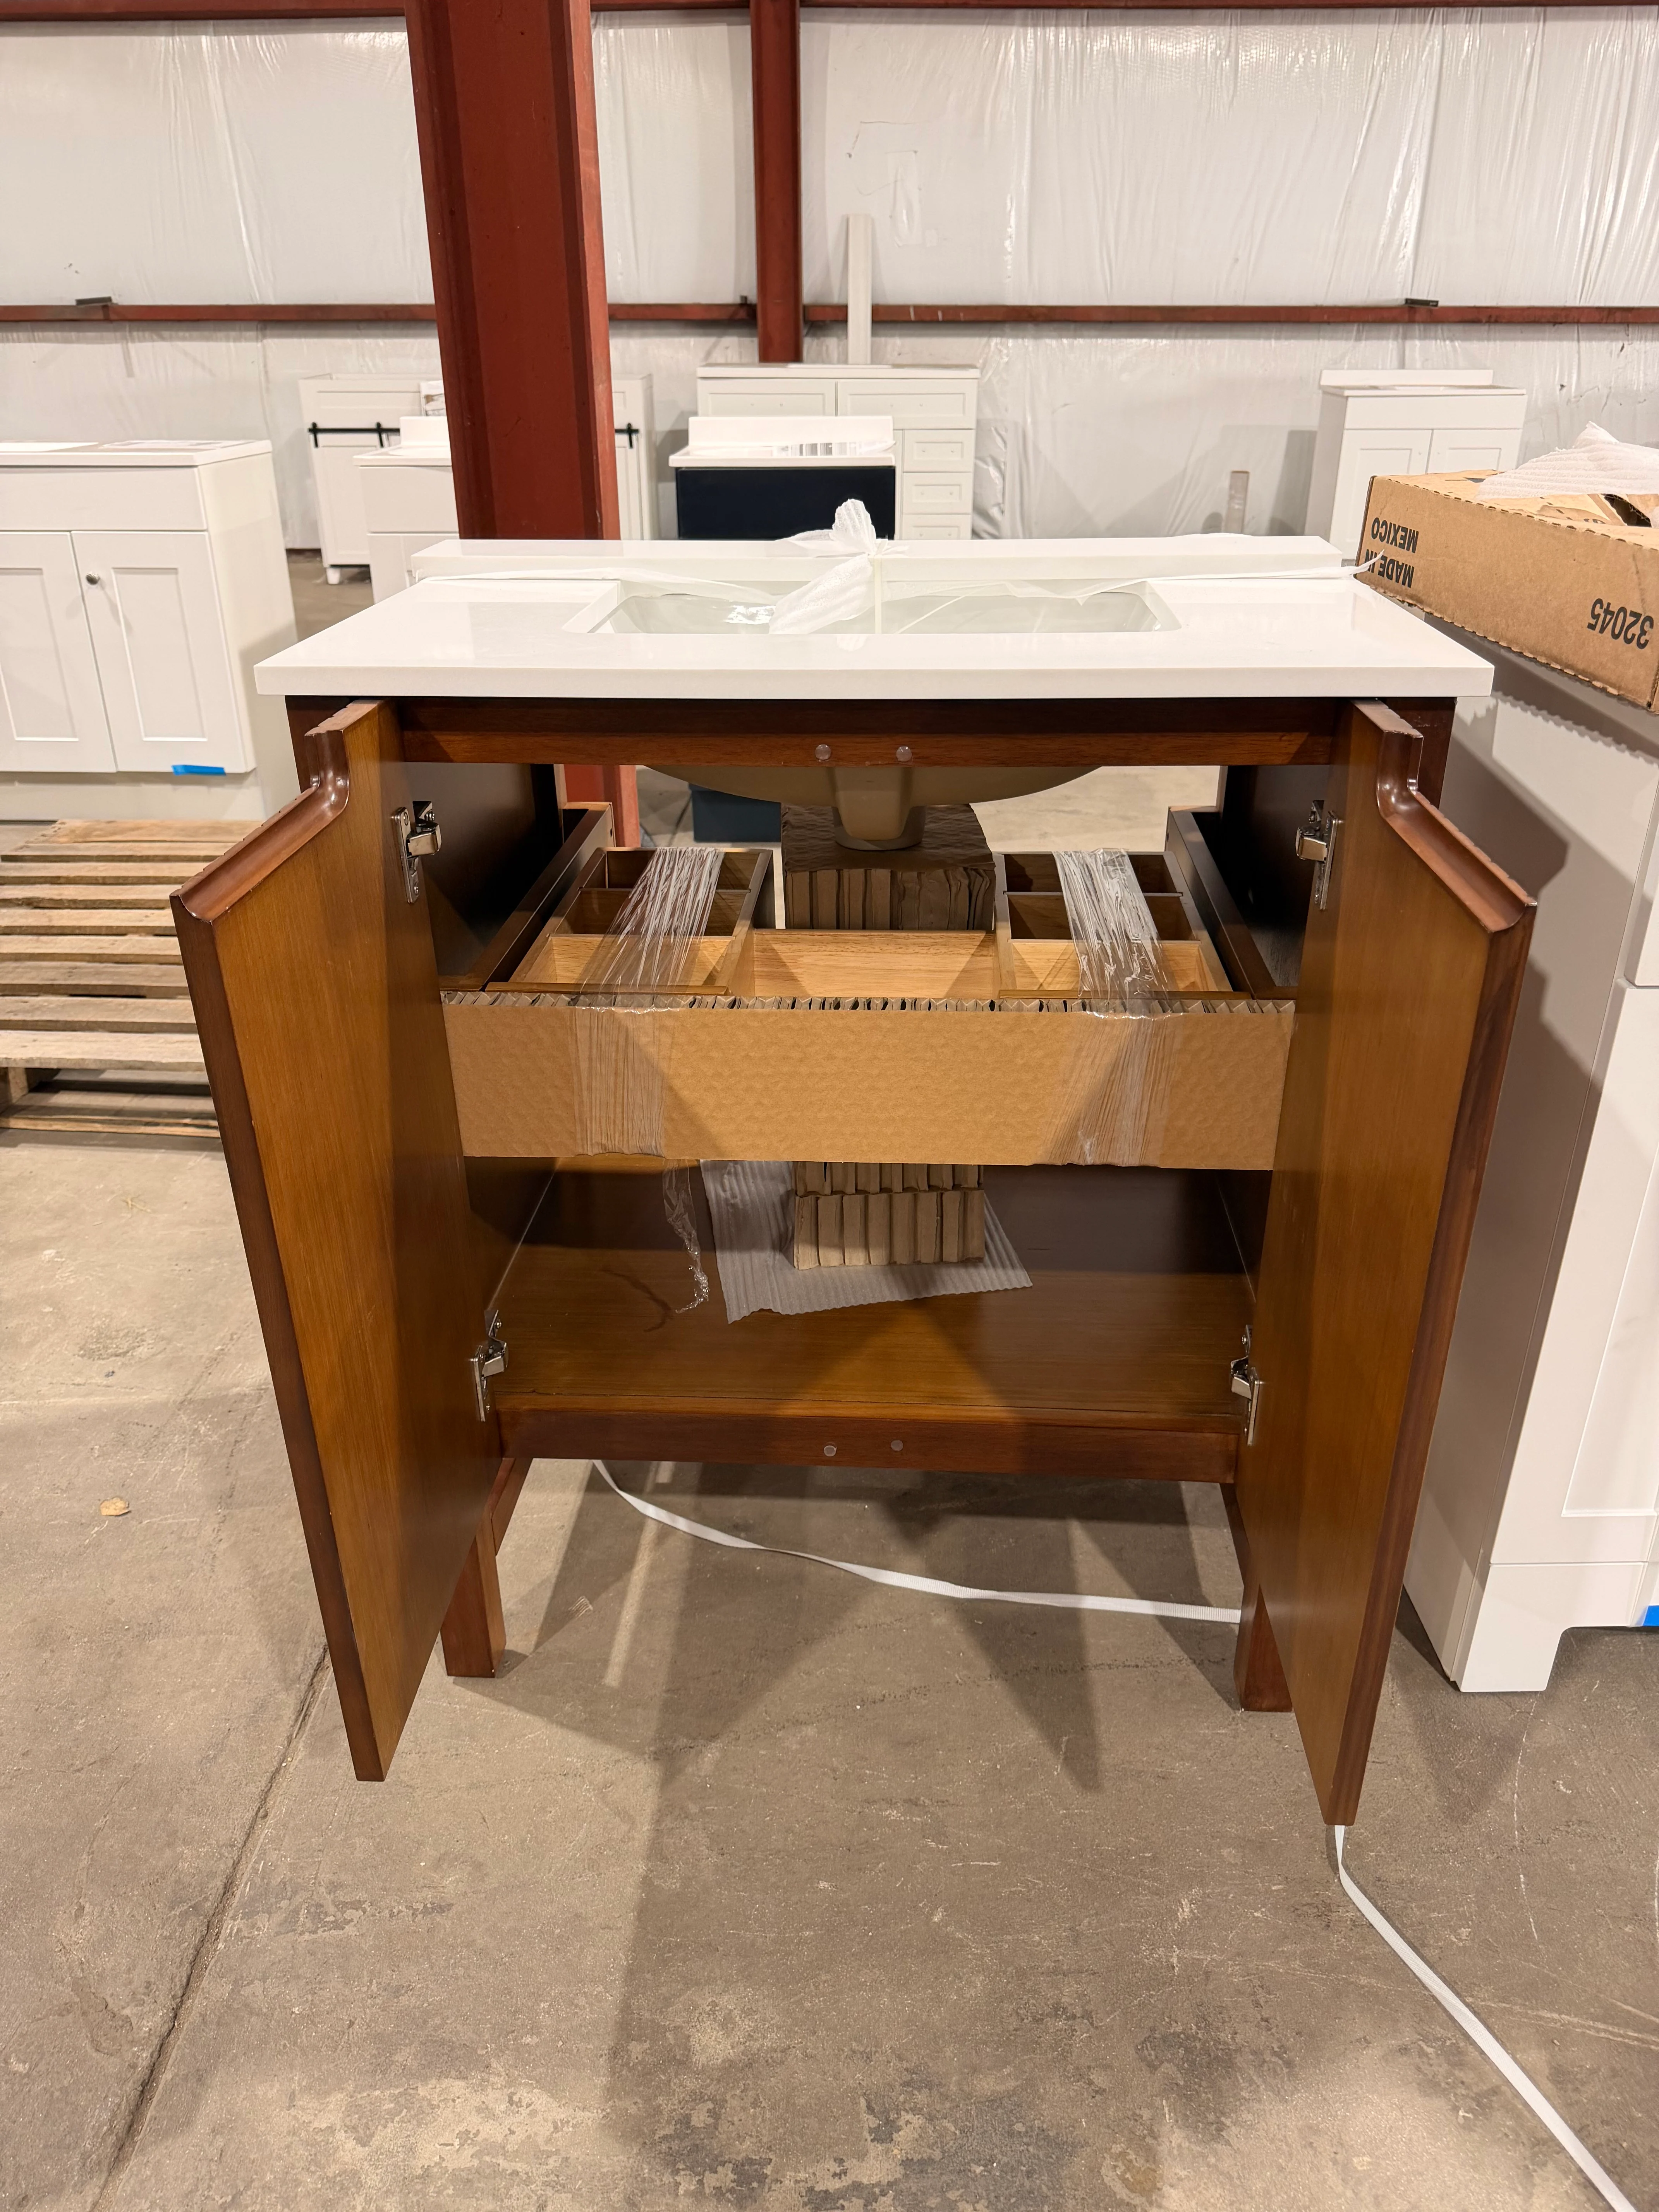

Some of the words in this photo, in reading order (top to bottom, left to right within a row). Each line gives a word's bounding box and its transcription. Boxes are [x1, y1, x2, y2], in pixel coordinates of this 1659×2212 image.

[1371, 517, 1419, 553] MEXICO
[1378, 555, 1415, 588] MADE
[1587, 598, 1654, 649] 32045
